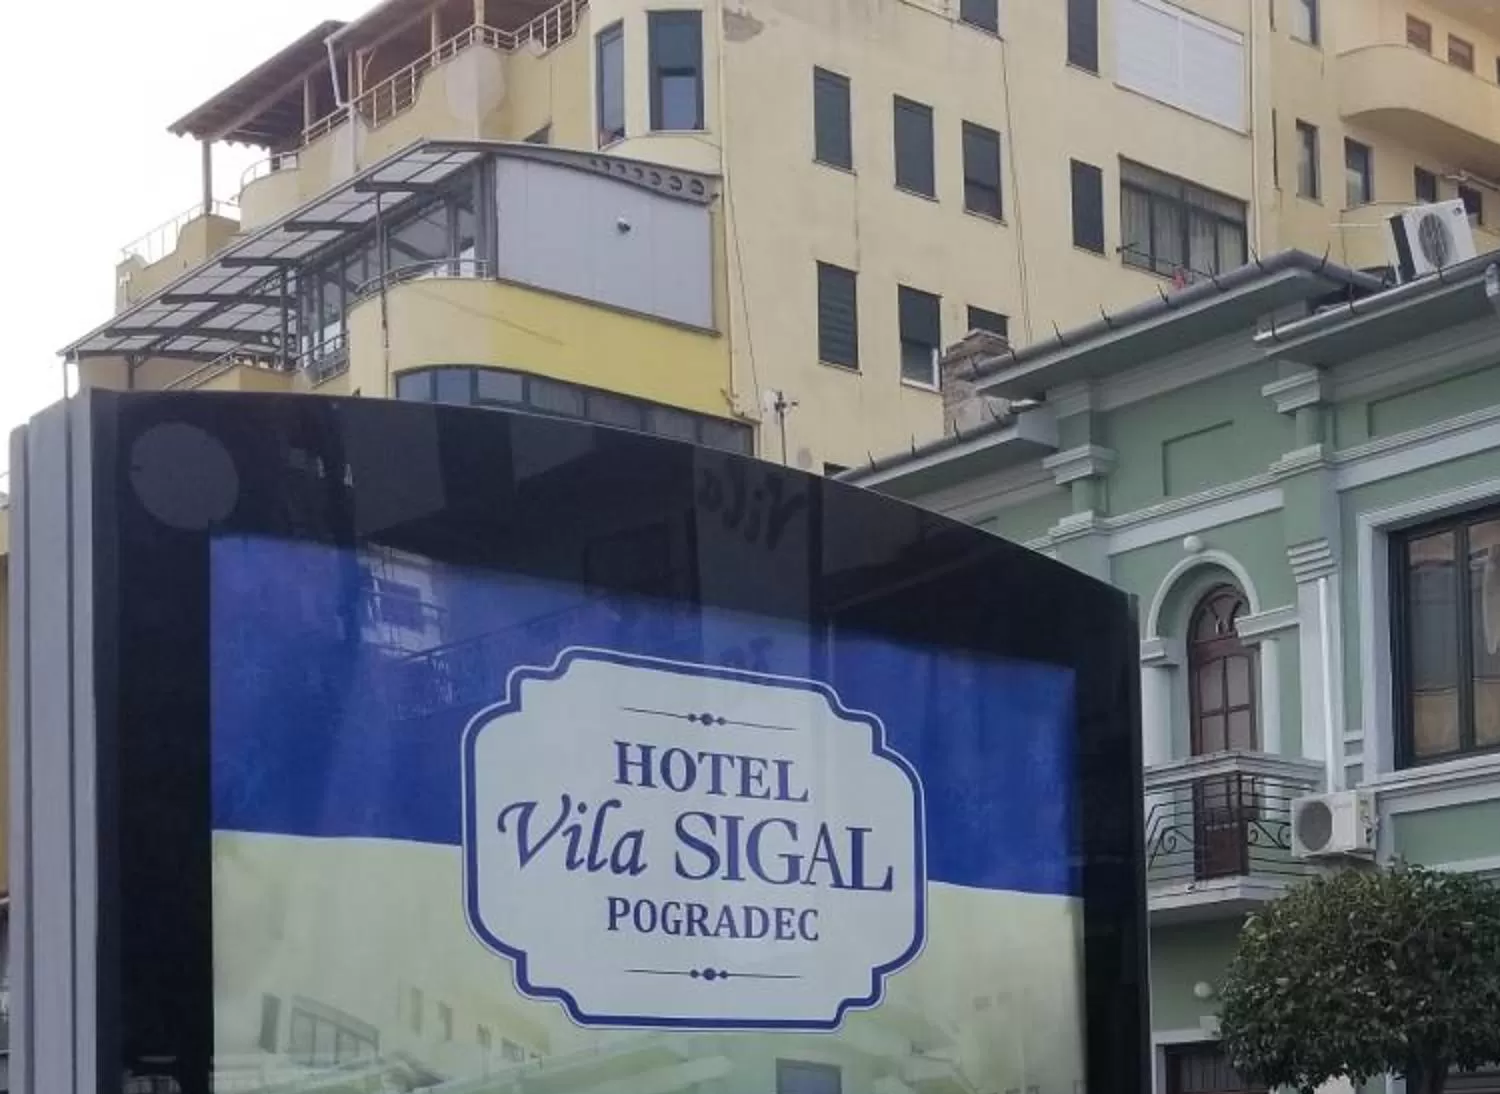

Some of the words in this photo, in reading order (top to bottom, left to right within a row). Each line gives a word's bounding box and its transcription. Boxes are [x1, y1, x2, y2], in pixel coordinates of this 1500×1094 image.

[612, 739, 810, 804] HOTEL
[496, 793, 649, 878] Vila
[673, 810, 895, 893] SIGAL
[606, 895, 821, 943] POGRADEC
